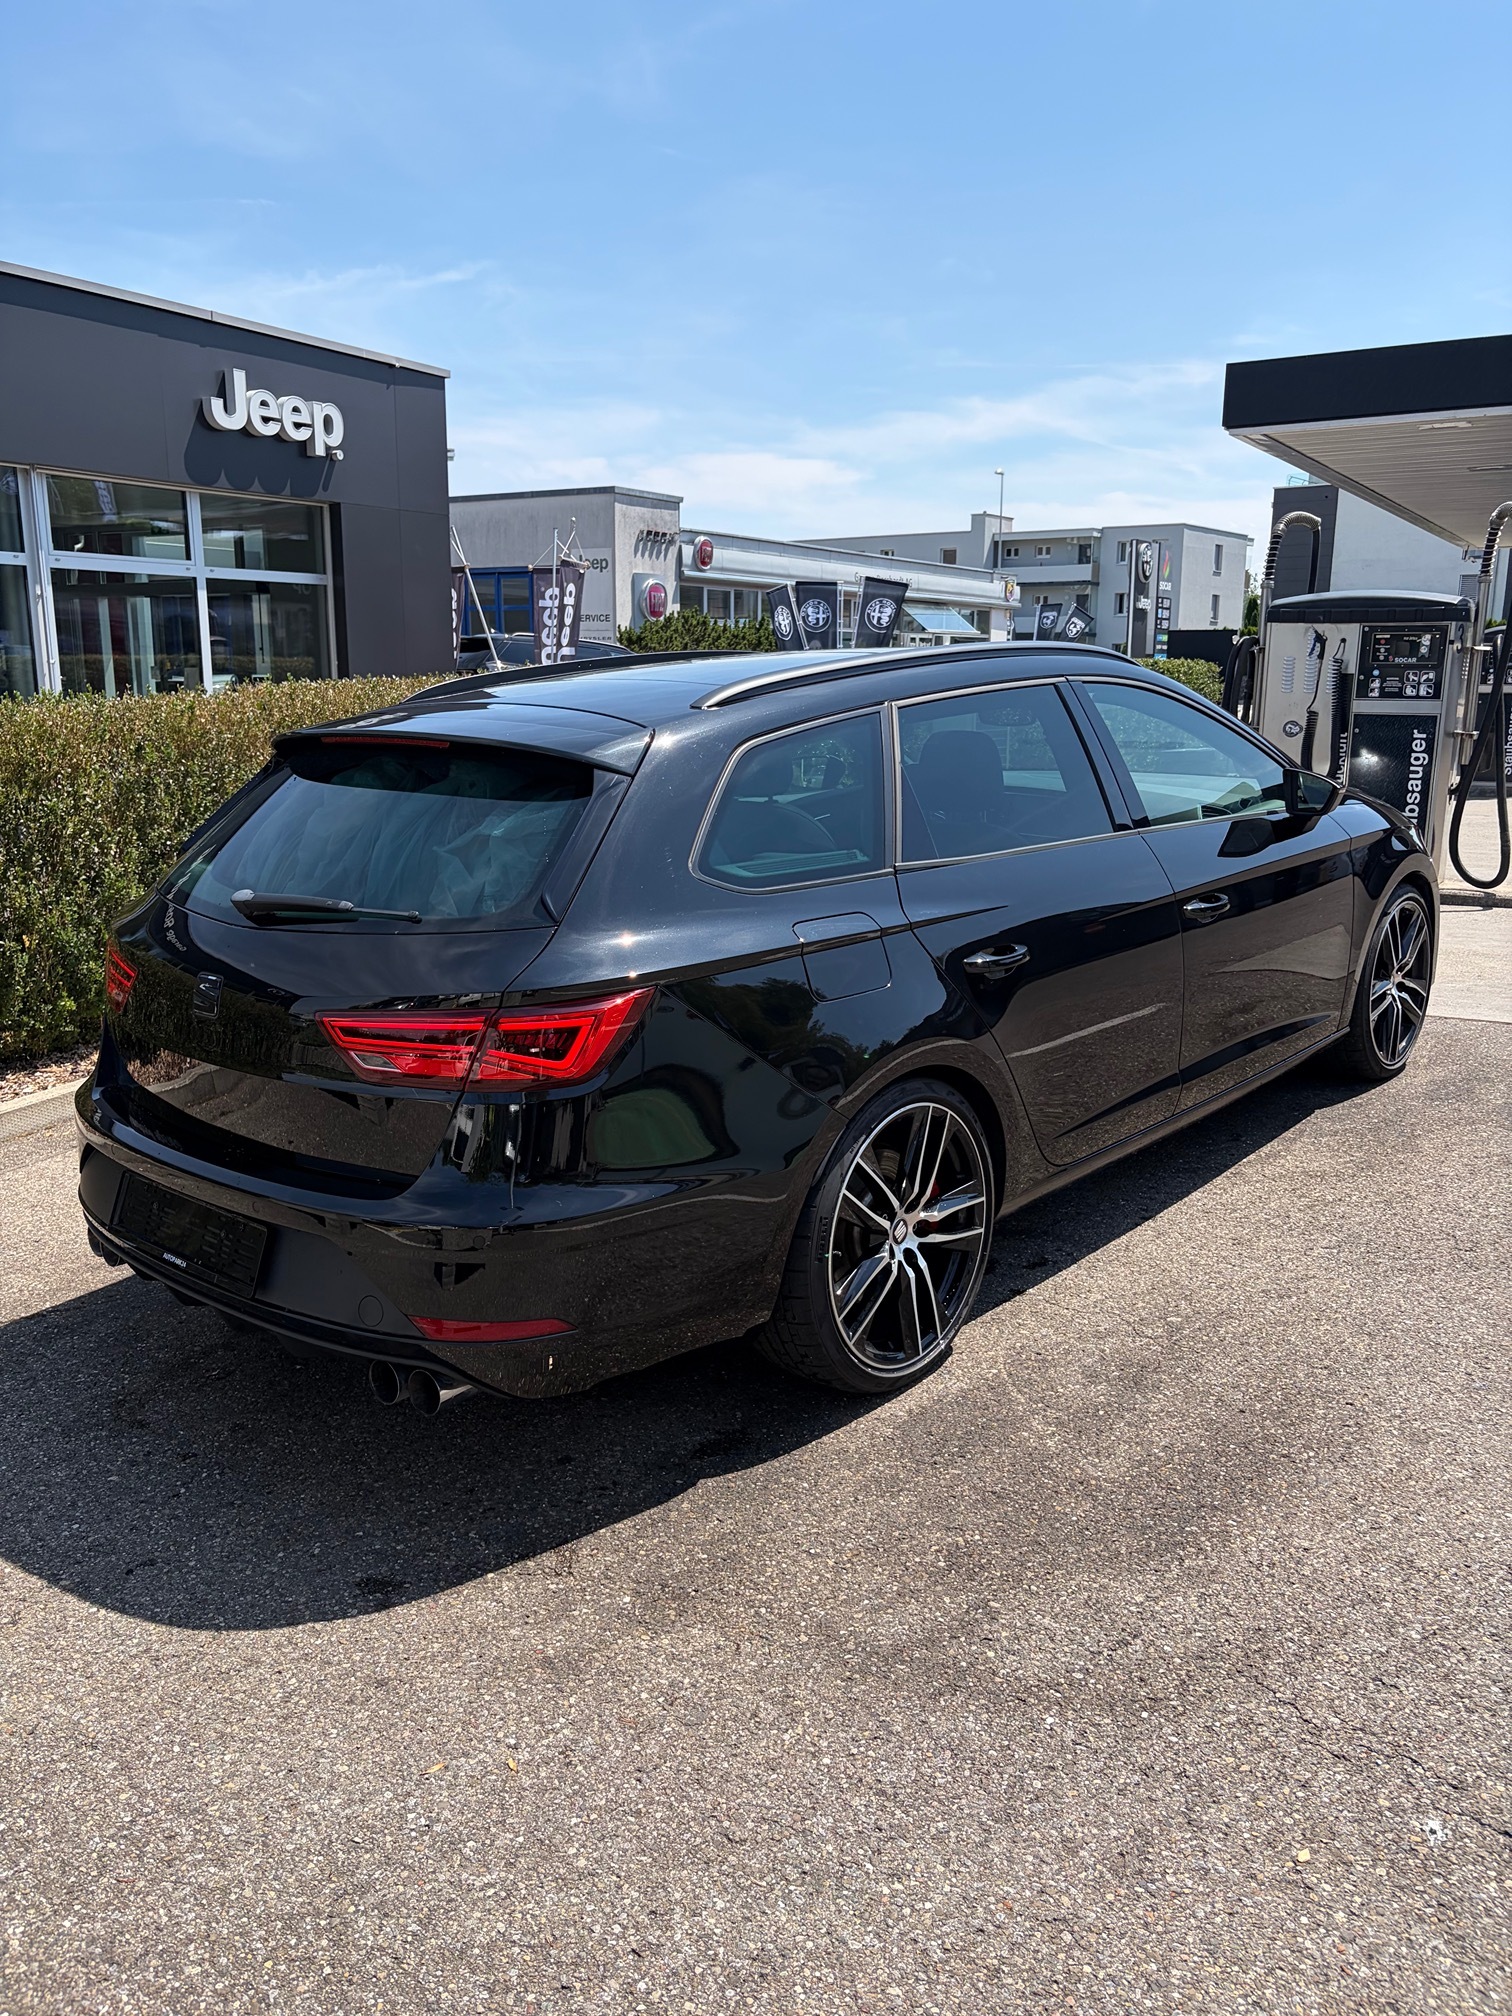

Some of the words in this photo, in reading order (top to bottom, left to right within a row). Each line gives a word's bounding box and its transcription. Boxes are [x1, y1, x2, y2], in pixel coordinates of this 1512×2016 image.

[203, 368, 344, 460] Jeep
[580, 614, 611, 622] ERVICE
[1402, 729, 1429, 824] bsauger
